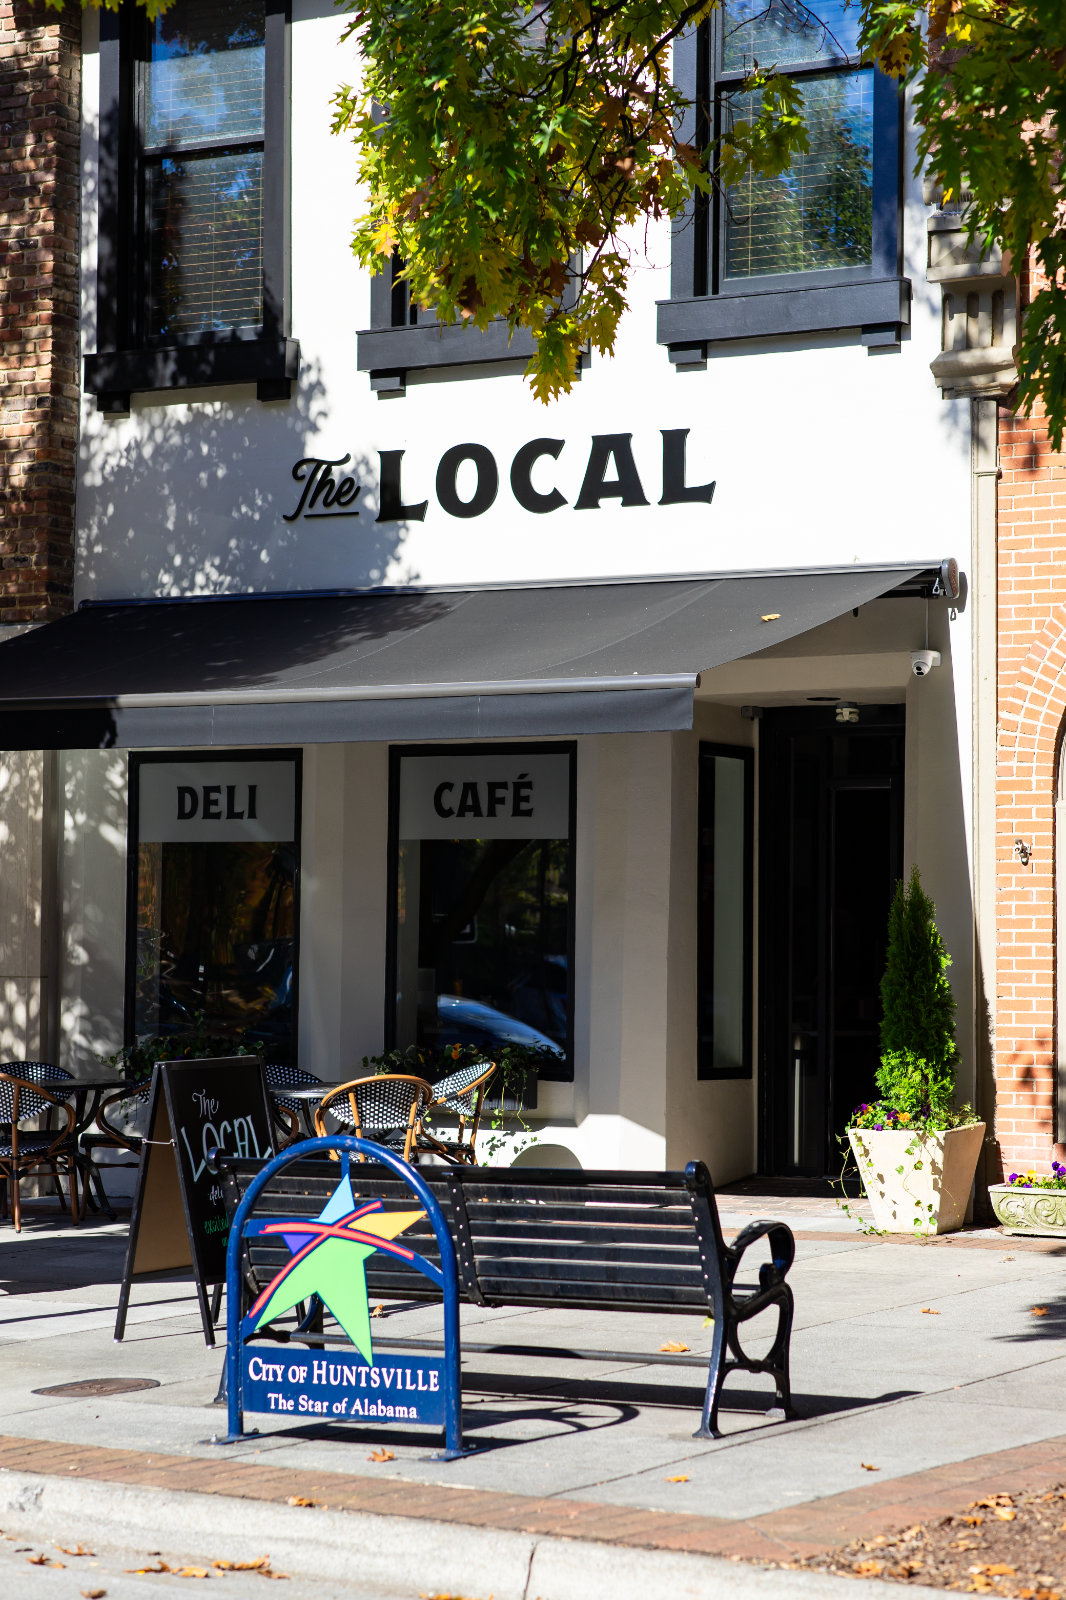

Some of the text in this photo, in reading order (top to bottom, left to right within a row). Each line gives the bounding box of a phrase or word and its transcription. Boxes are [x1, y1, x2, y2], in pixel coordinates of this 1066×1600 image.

[283, 428, 717, 522] The LOCAL
[176, 784, 258, 820] DELI
[433, 773, 534, 818] CAFÉ
[192, 1089, 219, 1120] The
[248, 1356, 440, 1392] CITY OF HUNTSVILLE
[267, 1393, 418, 1419] The Star of Alabama
